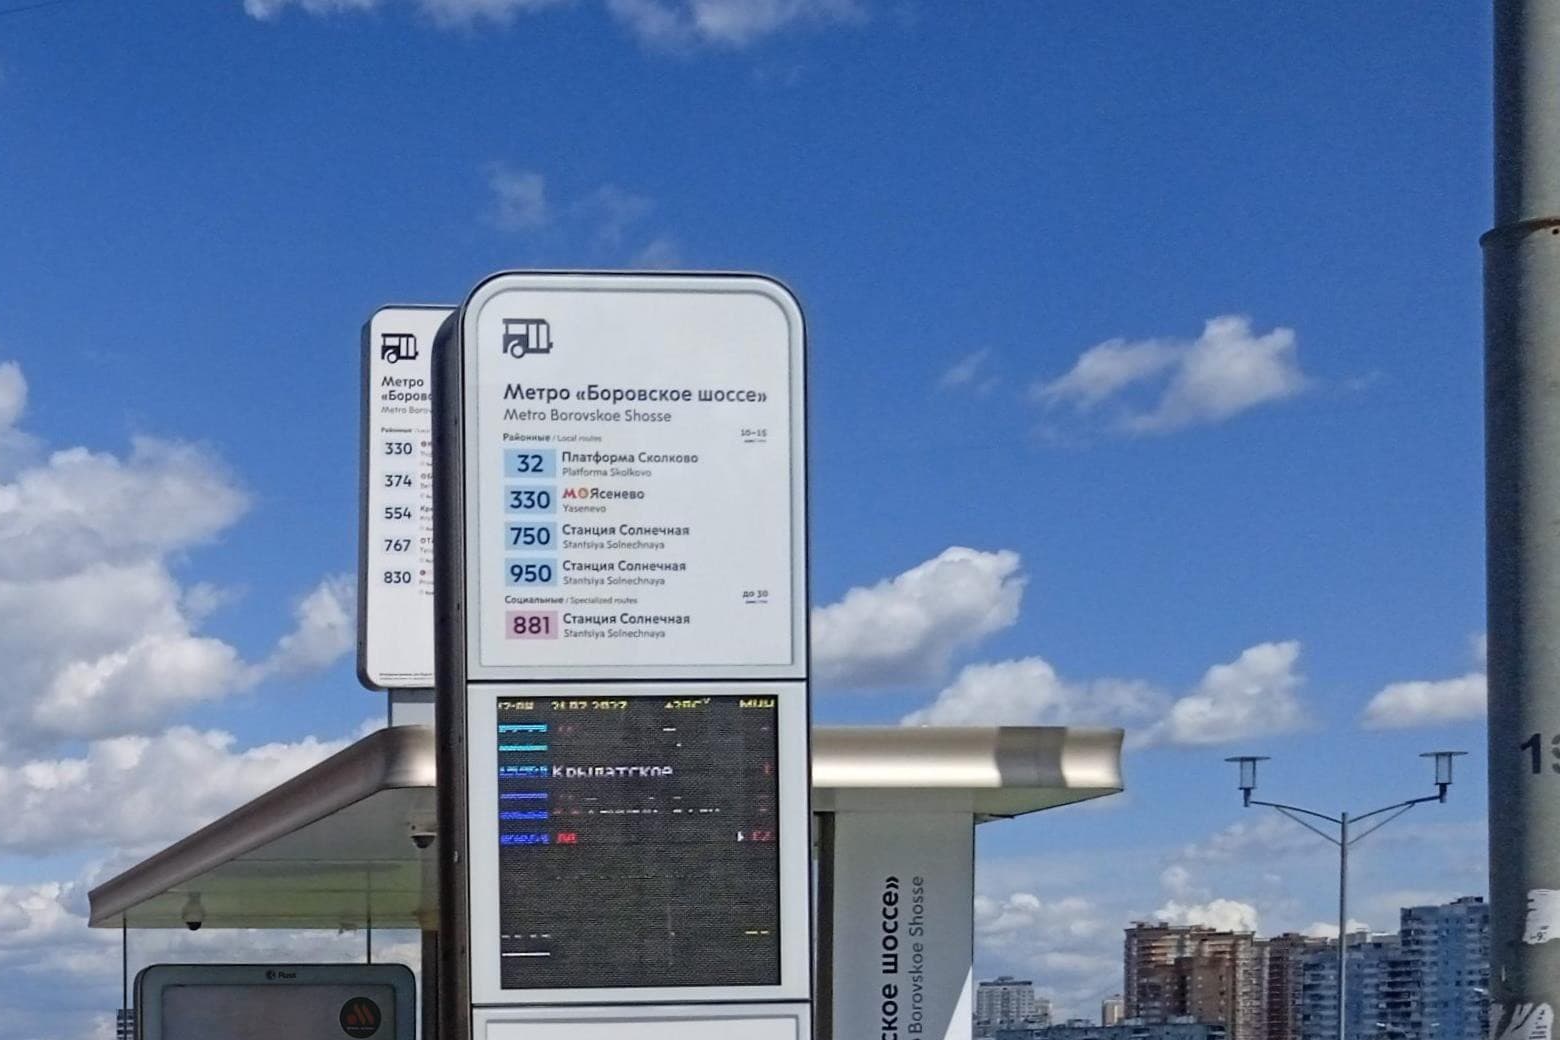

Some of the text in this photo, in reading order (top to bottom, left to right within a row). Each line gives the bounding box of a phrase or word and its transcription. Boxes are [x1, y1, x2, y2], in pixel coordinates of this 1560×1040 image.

[381, 376, 424, 389] Метро
[504, 384, 767, 405] Метро «Боровское шоссе»
[504, 409, 672, 422] Metro Borovskoe Shosse
[503, 432, 551, 442] Районные
[385, 442, 412, 455] 330
[517, 455, 544, 473] 32
[562, 452, 699, 464] Платформа Сколково
[562, 467, 652, 477] Platforma Skolkovo
[385, 474, 412, 487] 374
[510, 490, 551, 509] 330
[384, 507, 412, 519] 554
[563, 503, 606, 513] Yasenevo
[510, 527, 550, 545] 750
[562, 524, 690, 536] Станция Солнечная
[384, 539, 411, 552] 767
[510, 564, 552, 582] 950
[562, 560, 686, 573] Станция Солнечная
[384, 571, 411, 584] 830
[505, 595, 563, 604] Социальные
[513, 616, 550, 634] 881
[563, 613, 690, 625] Станция Солнечная
[908, 876, 924, 937] Shosse
[881, 875, 900, 974] шоссе»
[908, 942, 924, 1036] Borovskoe
